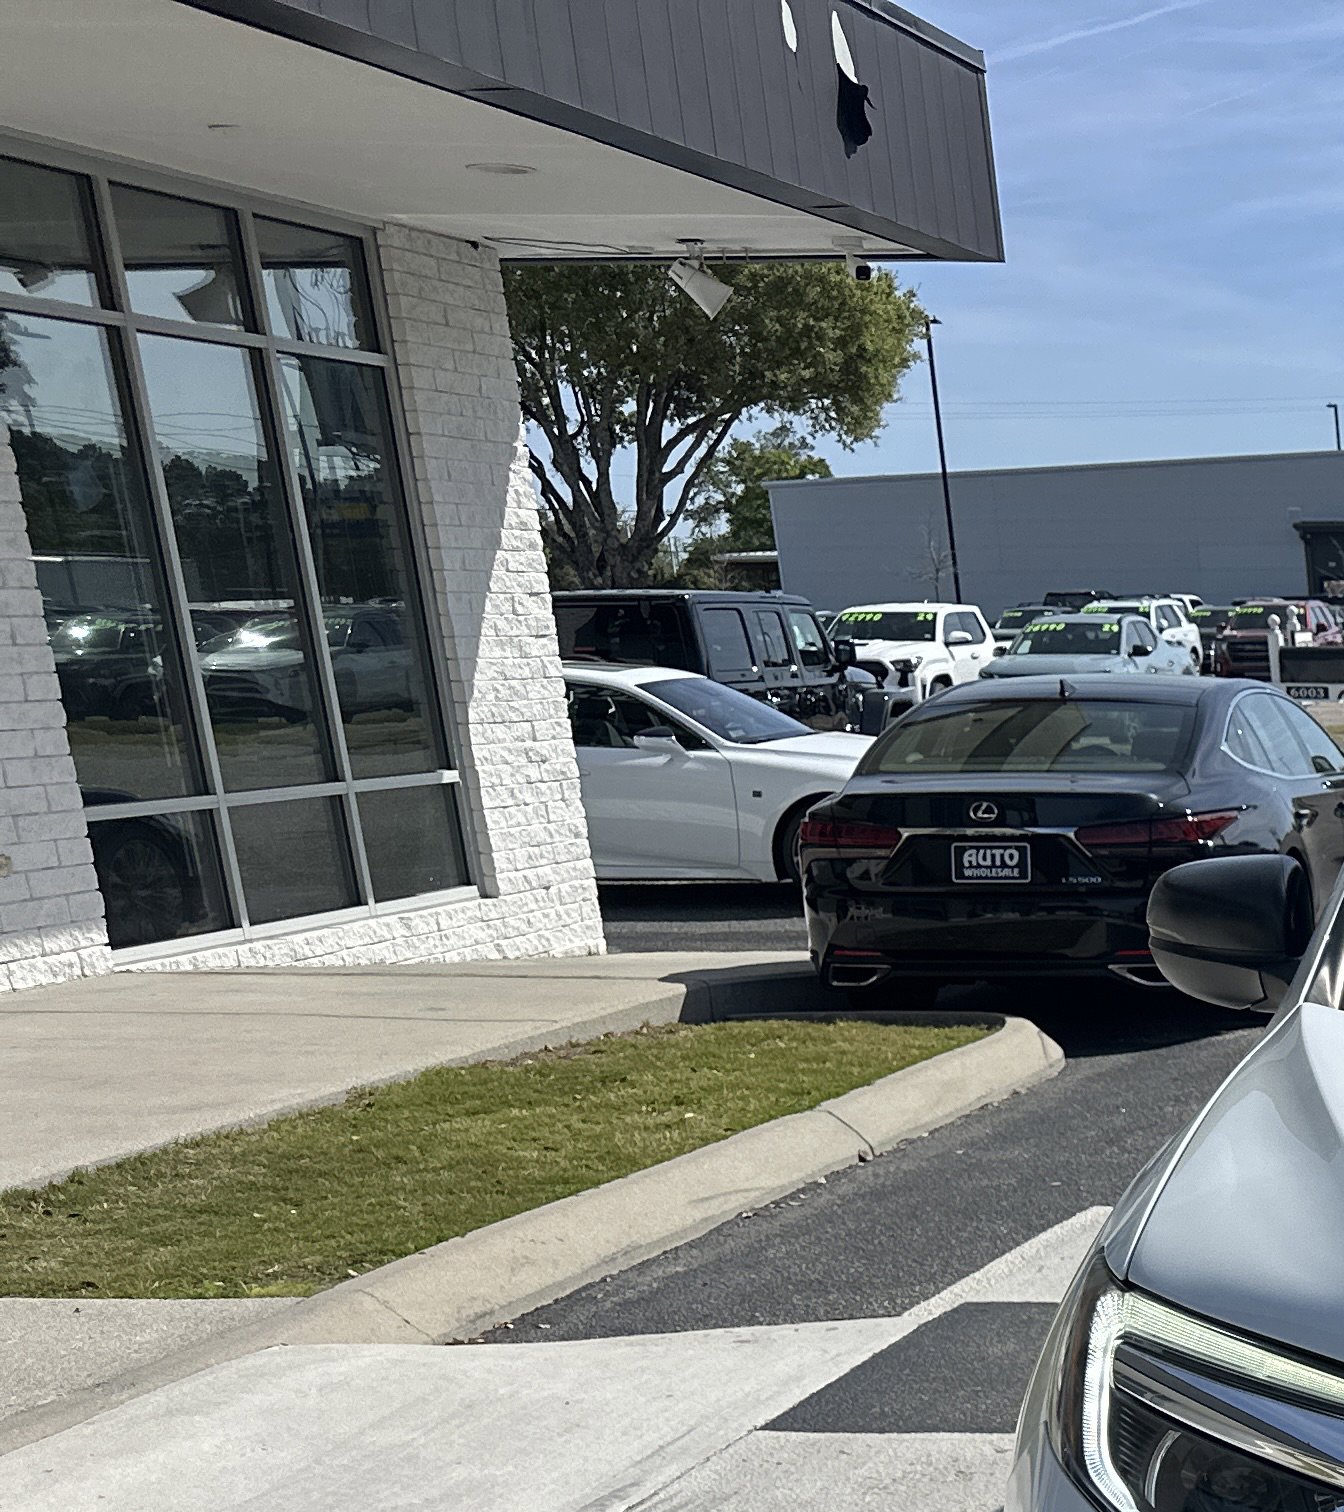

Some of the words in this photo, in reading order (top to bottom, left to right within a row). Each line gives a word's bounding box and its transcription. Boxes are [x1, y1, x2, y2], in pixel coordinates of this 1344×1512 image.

[1290, 687, 1325, 698] 6003
[962, 849, 1020, 867] AUTO
[963, 867, 1020, 877] WHOLESALE
